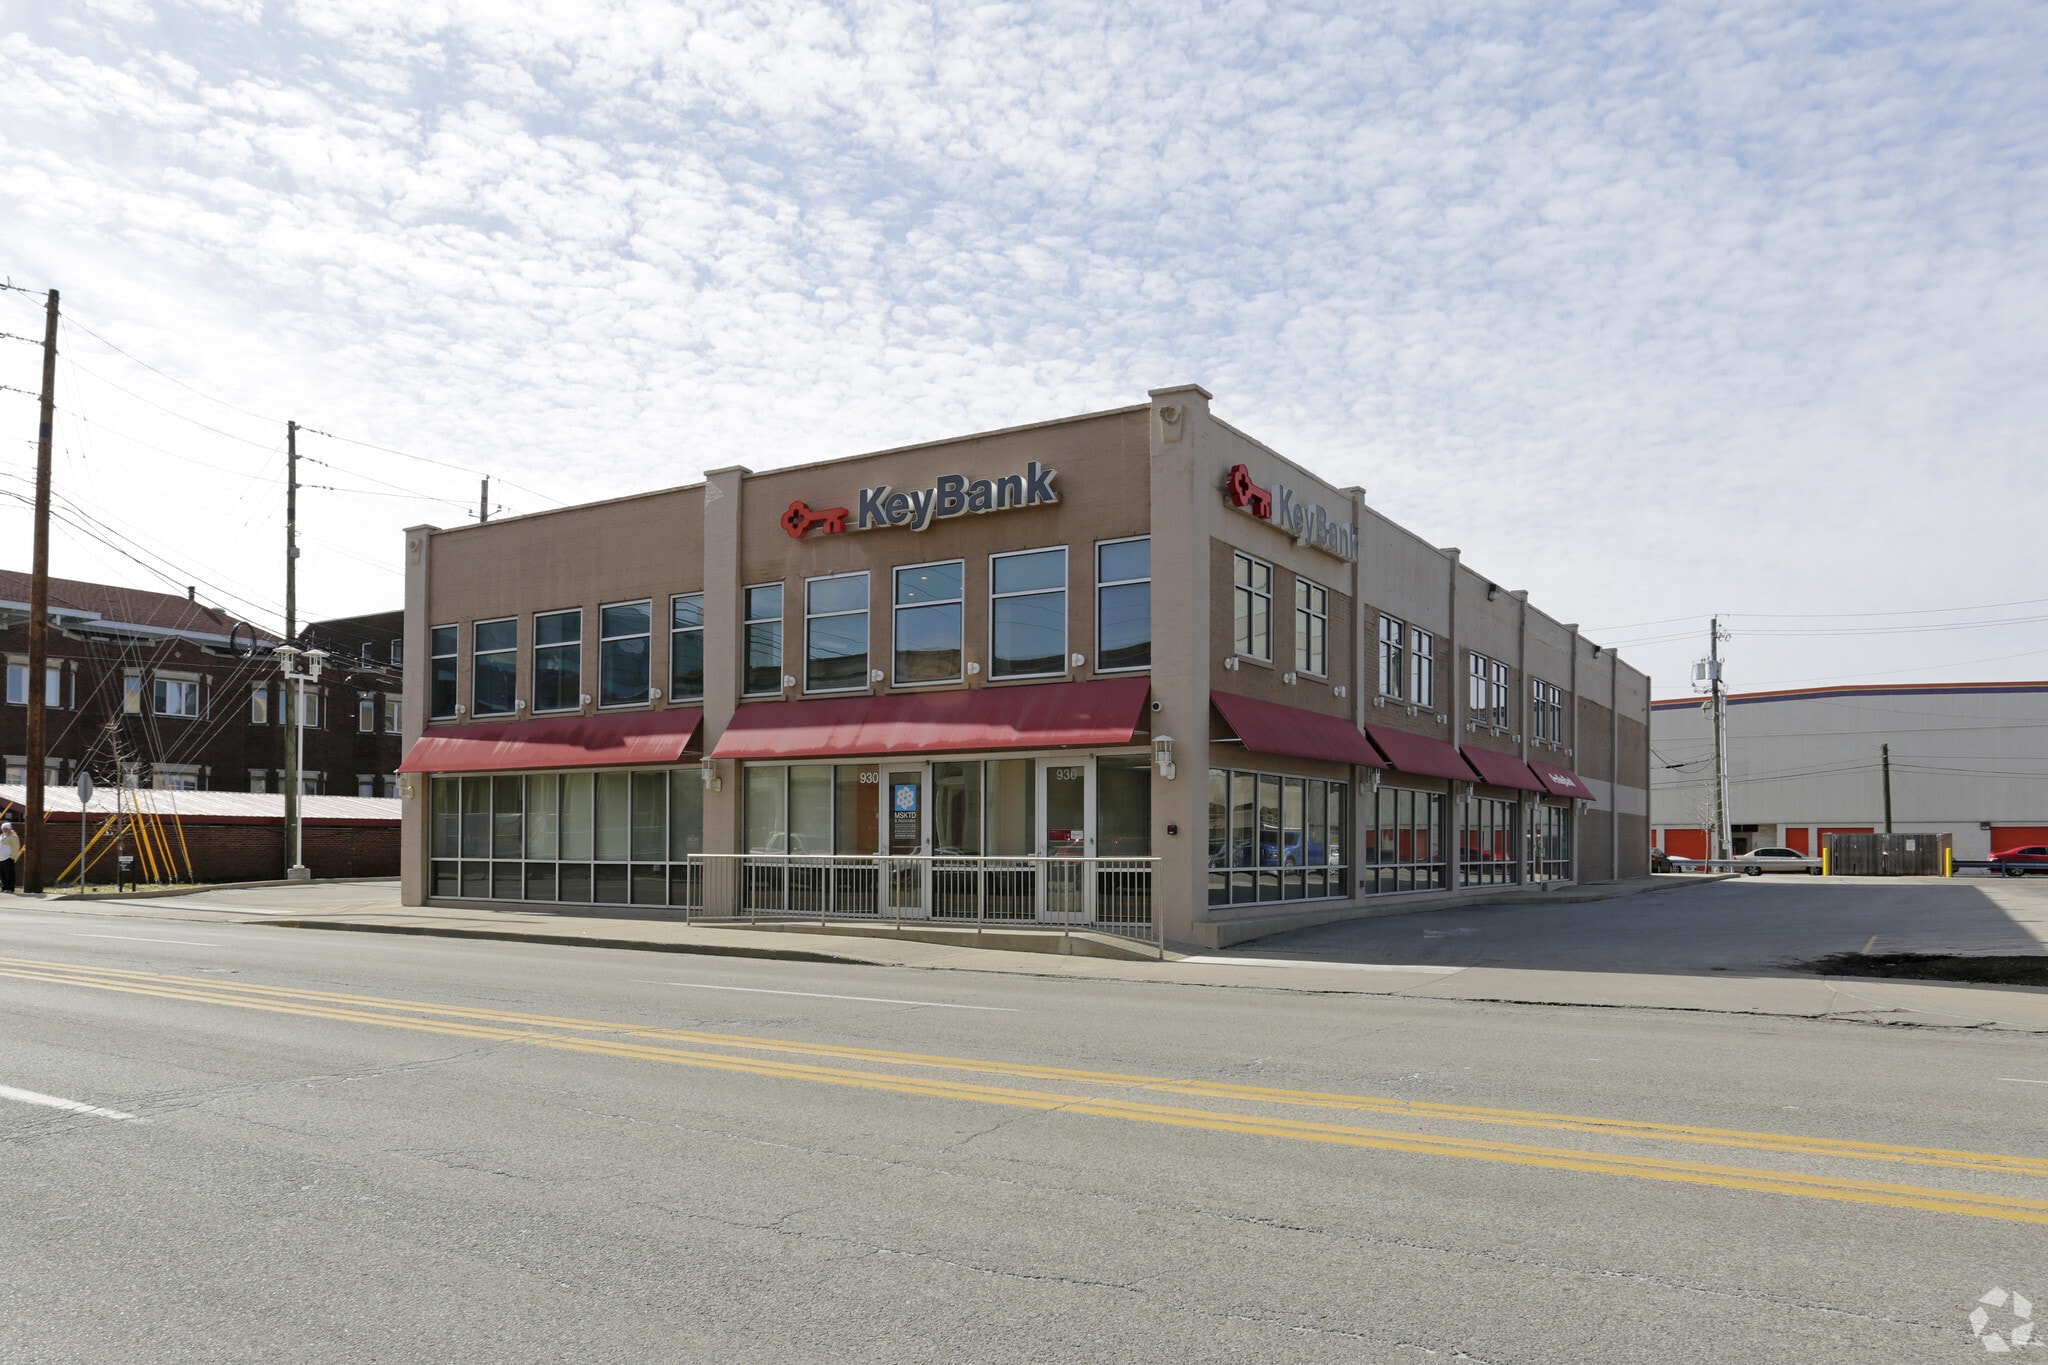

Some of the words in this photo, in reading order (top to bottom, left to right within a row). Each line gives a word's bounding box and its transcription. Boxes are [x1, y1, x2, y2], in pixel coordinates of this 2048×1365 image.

[857, 460, 1058, 532] KeyBank
[1273, 484, 1358, 562] KeyBank
[860, 772, 879, 784] 930
[1056, 769, 1077, 780] 930
[894, 811, 917, 819] MSKTD
